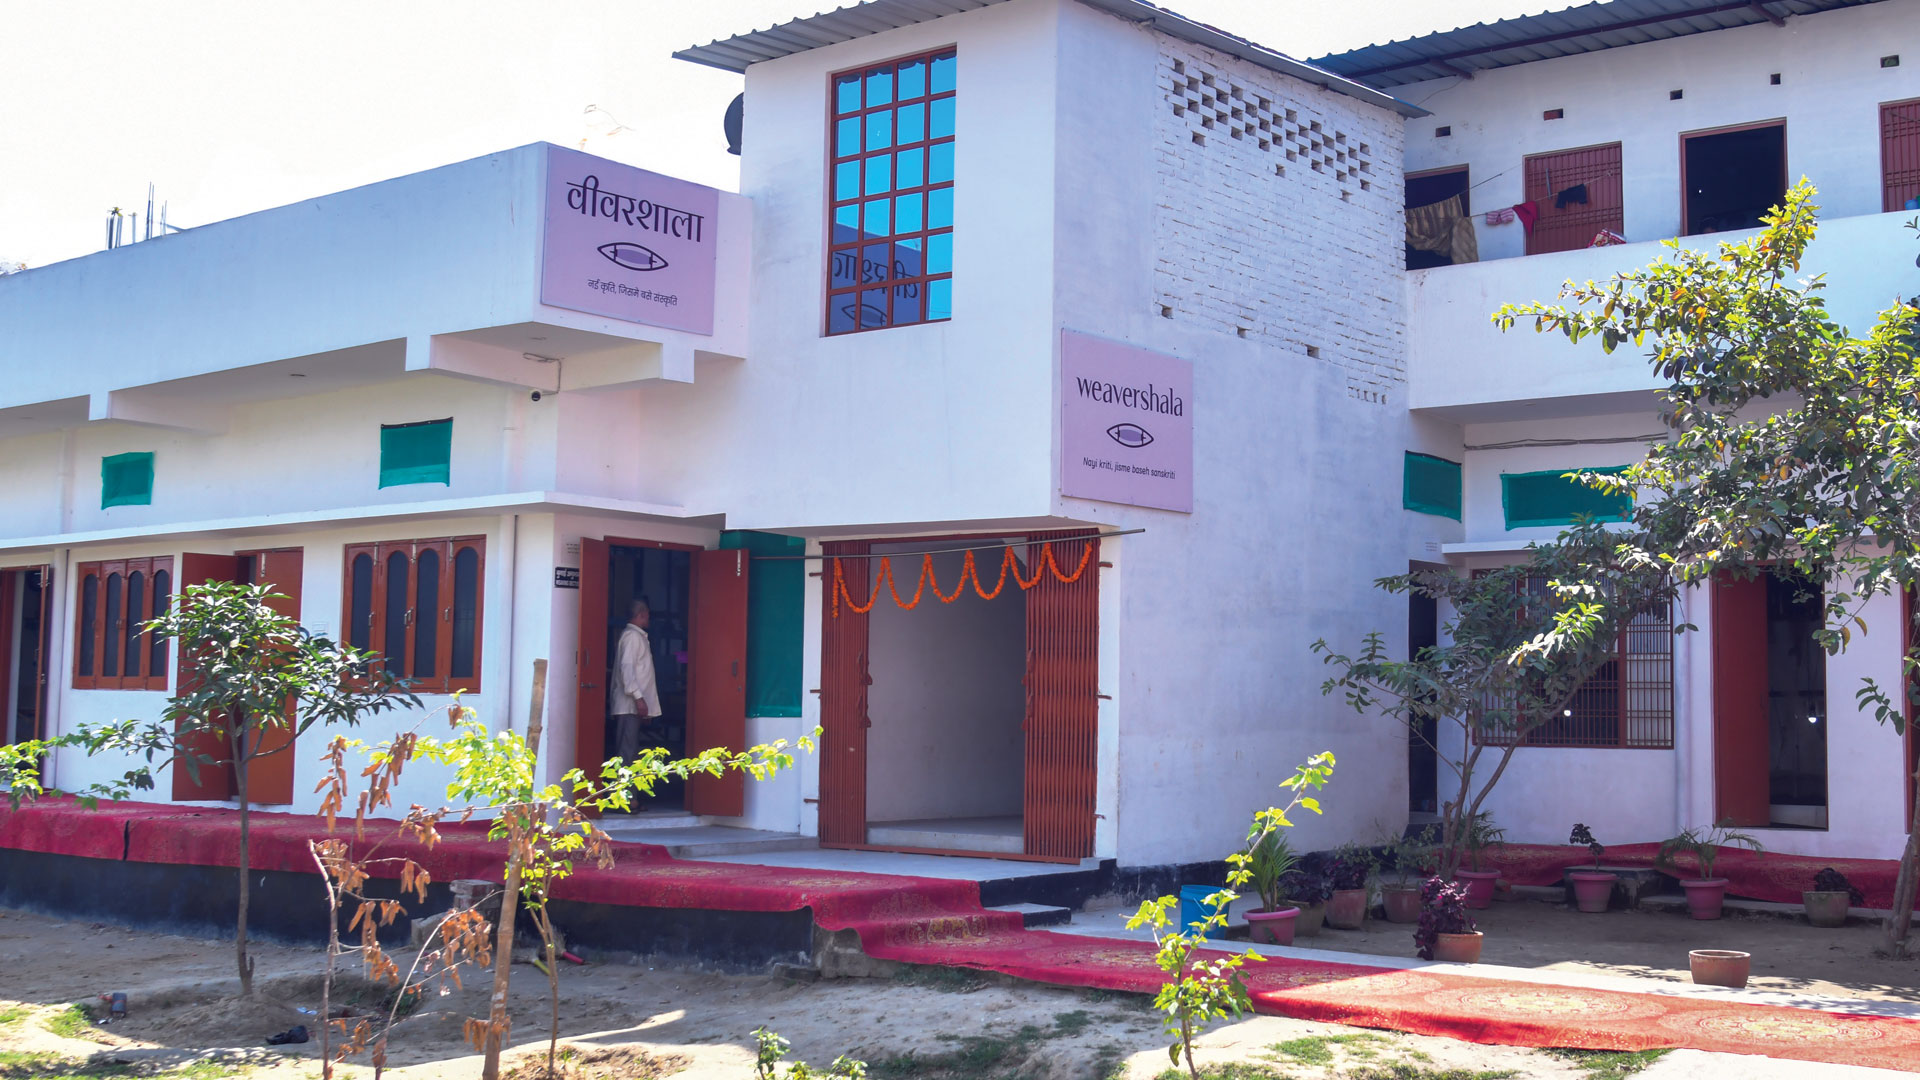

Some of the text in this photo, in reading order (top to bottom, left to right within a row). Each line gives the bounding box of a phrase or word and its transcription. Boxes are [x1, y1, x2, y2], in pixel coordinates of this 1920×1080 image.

[567, 175, 704, 243] वीवरशाला
[1076, 376, 1183, 417] weavershala
[1083, 456, 1176, 480] Nayi kriti, jisme baseh sanskriti
